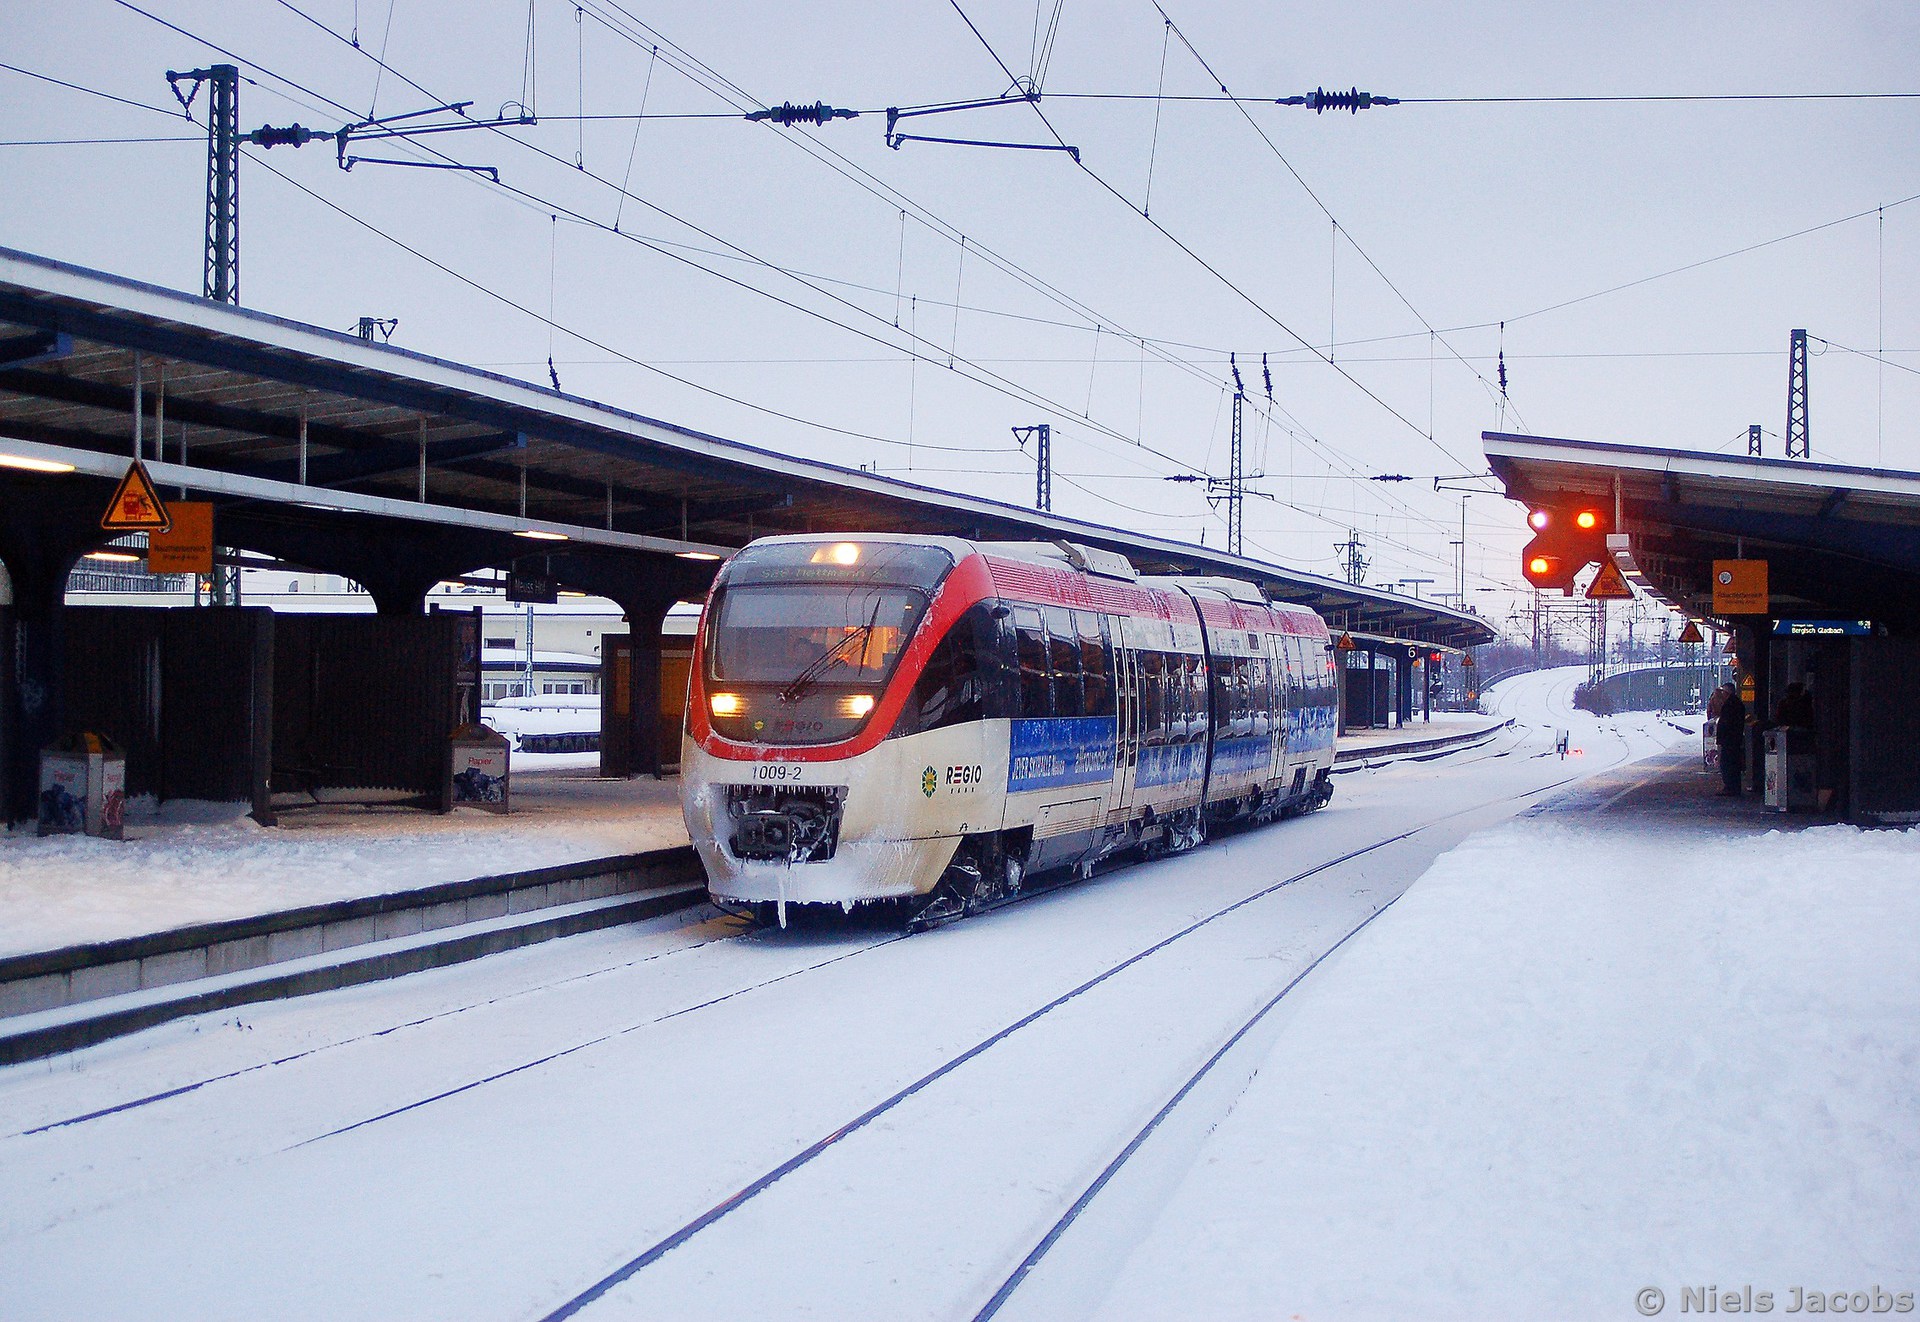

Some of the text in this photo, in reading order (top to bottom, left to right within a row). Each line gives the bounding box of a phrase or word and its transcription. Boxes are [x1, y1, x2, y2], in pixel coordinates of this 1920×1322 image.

[1772, 619, 1780, 631] 7
[1791, 627, 1816, 635] Bergisch
[1408, 646, 1416, 658] 6
[752, 765, 802, 780] 1009-2
[945, 764, 983, 785] REGIO
